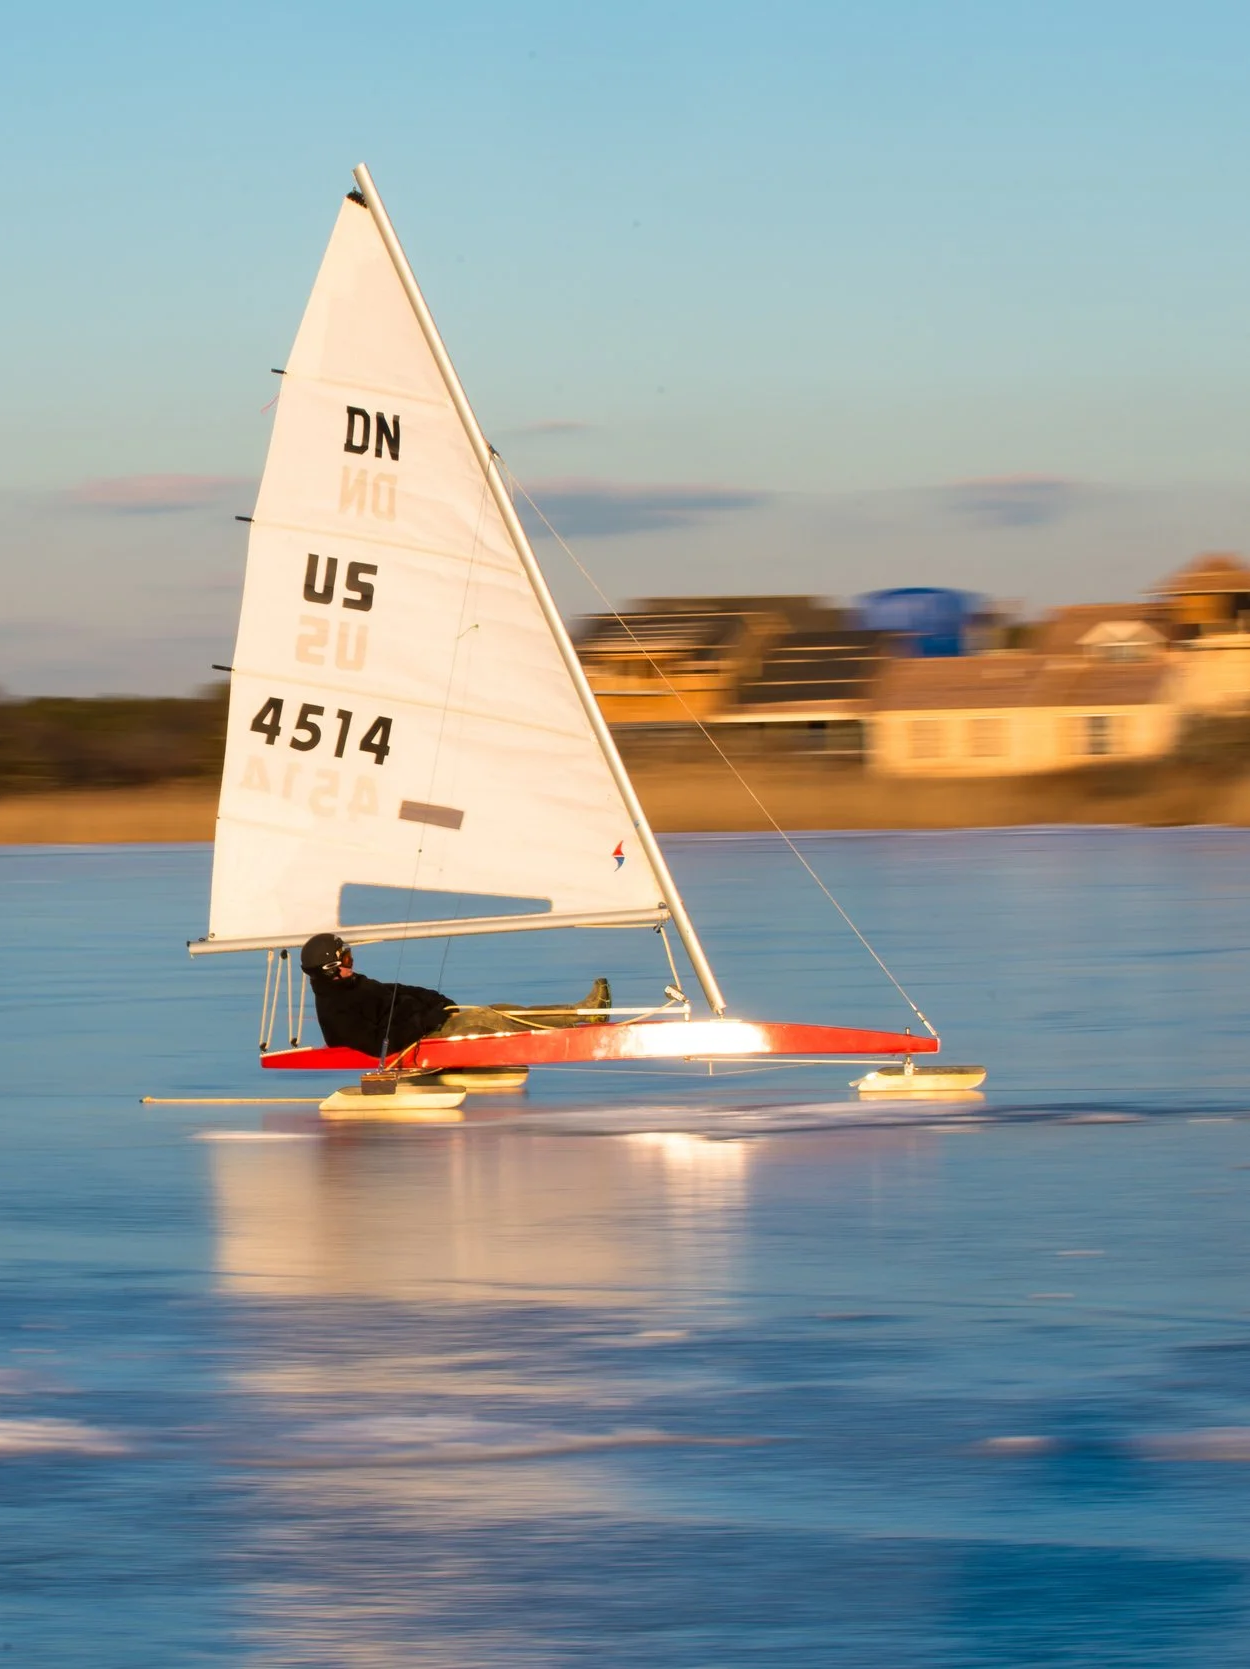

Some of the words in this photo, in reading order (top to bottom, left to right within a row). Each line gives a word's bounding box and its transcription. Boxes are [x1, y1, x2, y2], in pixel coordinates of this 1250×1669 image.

[343, 405, 401, 462] DN
[302, 553, 378, 612] US
[250, 697, 393, 765] 4514
